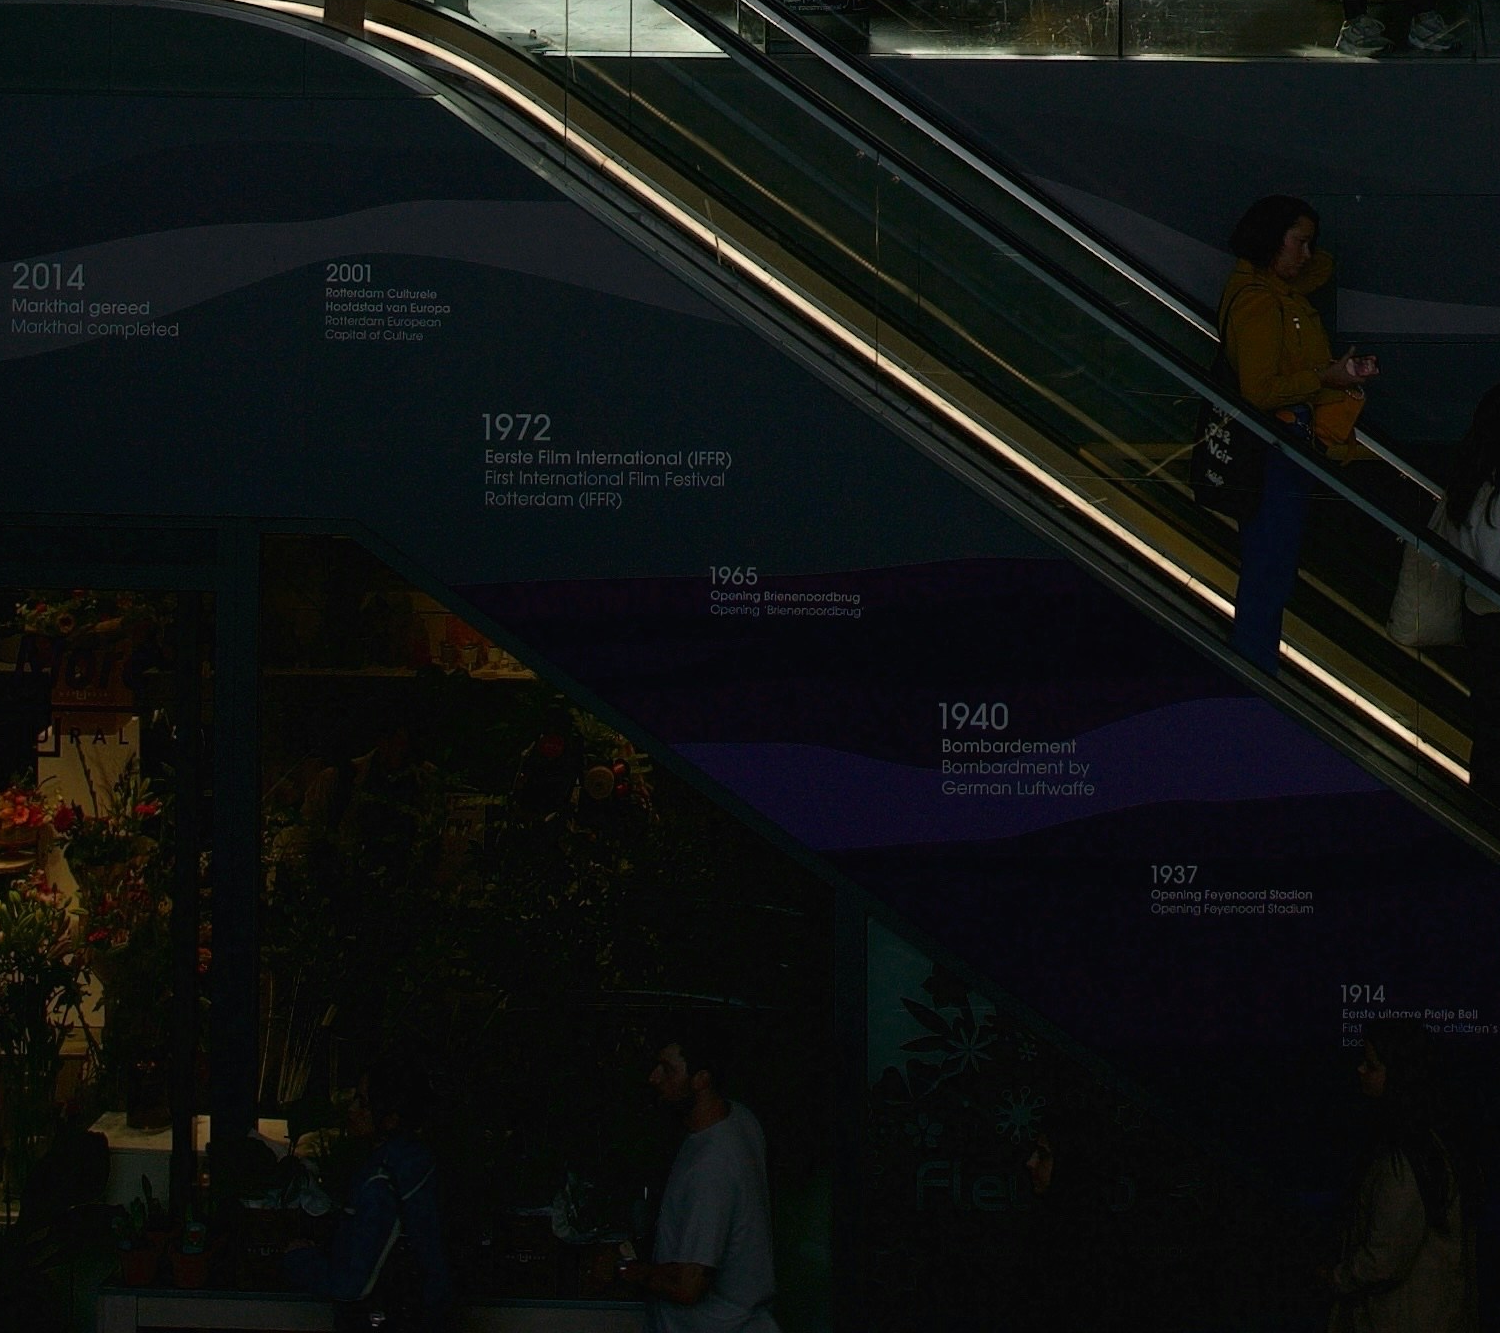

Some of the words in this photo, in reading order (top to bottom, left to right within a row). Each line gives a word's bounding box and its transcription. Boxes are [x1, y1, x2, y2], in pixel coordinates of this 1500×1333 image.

[11, 262, 86, 292] 2014
[325, 263, 373, 284] 2001
[325, 287, 385, 299] Rotterdam
[387, 287, 437, 299] Culturele
[11, 296, 84, 315] Markthal
[88, 299, 151, 318] gereed
[325, 301, 384, 314] Hoofdstad
[386, 303, 407, 314] van
[409, 301, 451, 315] Europa
[11, 318, 84, 336] Markthal
[86, 319, 180, 340] completed
[325, 314, 385, 327] Rotterdam
[388, 315, 442, 329] European
[325, 328, 368, 343] Capital
[369, 329, 381, 341] of
[383, 329, 424, 342] Culture
[481, 413, 552, 441] 1972
[485, 450, 534, 465] Eerste
[537, 450, 572, 465] Film
[575, 450, 682, 466] International
[687, 451, 732, 470] (IFFR)
[485, 470, 514, 485] First
[518, 471, 624, 486] International
[627, 471, 660, 486] Film
[664, 471, 726, 487] Festival
[485, 491, 574, 507] Rotterdam
[578, 491, 622, 510] (IFFR)
[708, 566, 758, 586] 1965
[710, 590, 761, 603] Opening
[763, 590, 861, 605] Brienenoordbrug
[710, 604, 760, 617] Opening
[937, 702, 1010, 731] 1940
[941, 738, 1077, 755] Bombardement
[941, 759, 1065, 775] Bombardment
[1068, 760, 1091, 779] by
[941, 779, 1012, 796] German
[1016, 780, 1096, 797] Luftwaffe
[1149, 864, 1199, 884] 1937
[1150, 888, 1202, 902] Opening
[1203, 889, 1265, 902] Feyenoord
[1267, 888, 1313, 901] Stadion
[1150, 902, 1202, 916] Opening
[1203, 902, 1265, 916] Feyenoord
[1267, 902, 1314, 915] Stadium
[1340, 984, 1386, 1004] 1914
[1342, 1008, 1376, 1020] Eerste
[1457, 1008, 1479, 1020] Bell
[1341, 1022, 1362, 1034] First
[1443, 1022, 1499, 1035] children's
